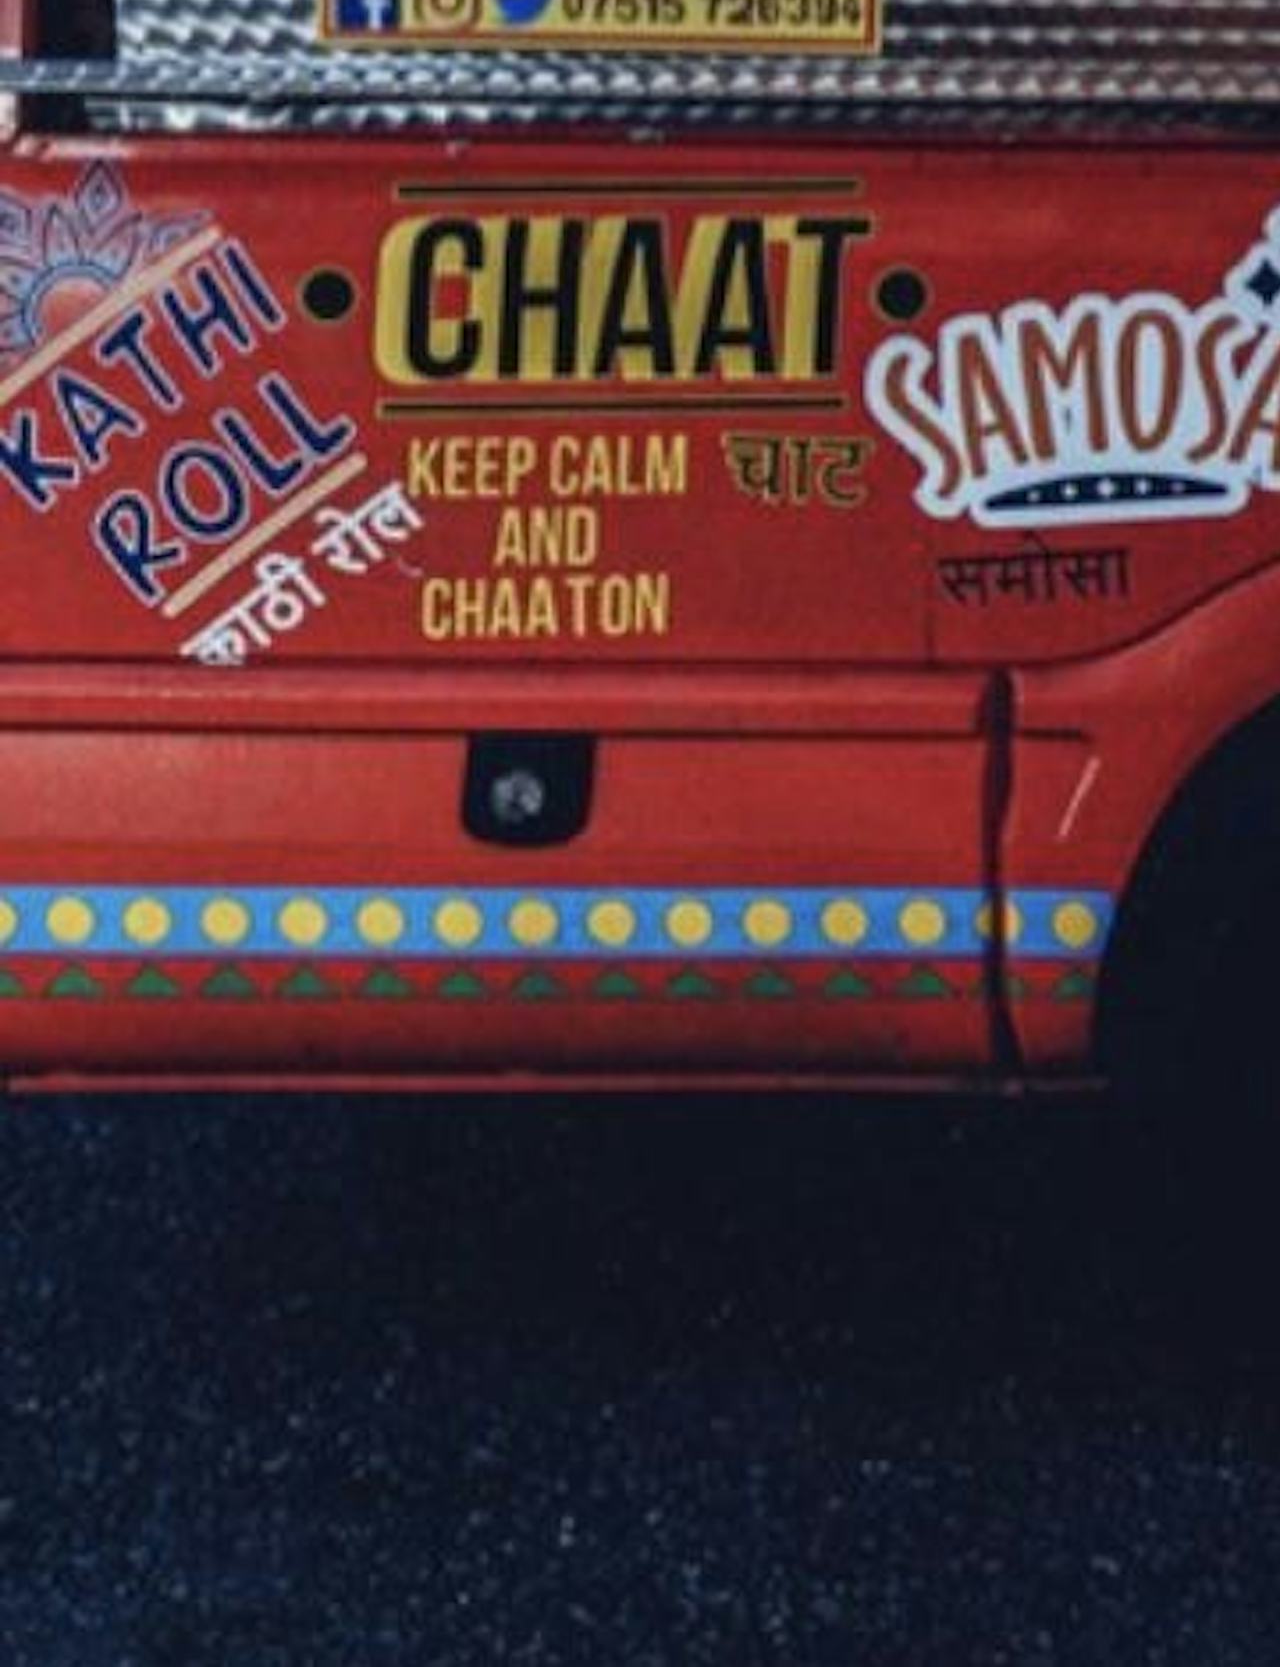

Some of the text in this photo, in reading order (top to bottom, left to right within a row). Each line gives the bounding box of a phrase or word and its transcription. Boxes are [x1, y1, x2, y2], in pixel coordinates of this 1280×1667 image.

[378, 215, 873, 383] CHAAT
[0, 237, 286, 510] KATHI
[95, 373, 357, 608] ROLL
[408, 434, 688, 497] KEEP CALM
[722, 432, 874, 508] चाट
[494, 505, 598, 568] AND
[937, 531, 1130, 606] समोसा
[179, 553, 325, 666] काठी
[421, 574, 670, 641] CHAATON
